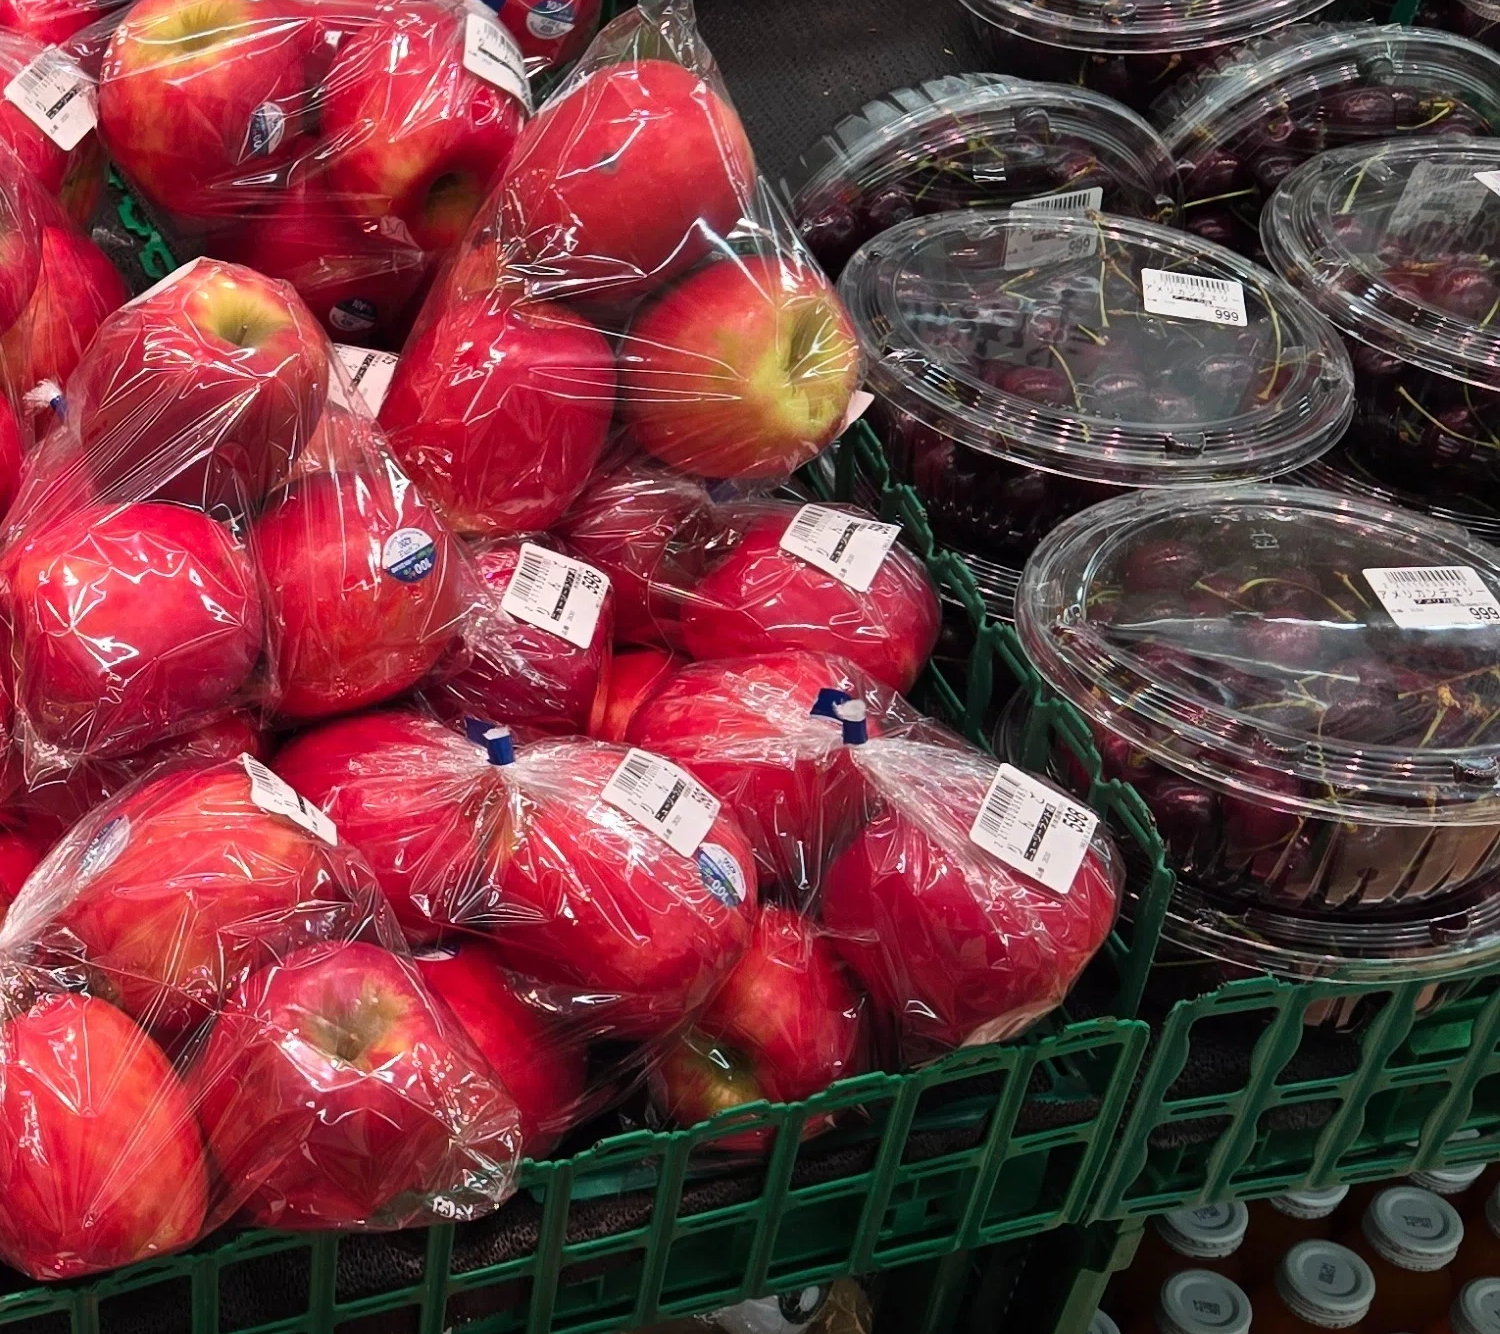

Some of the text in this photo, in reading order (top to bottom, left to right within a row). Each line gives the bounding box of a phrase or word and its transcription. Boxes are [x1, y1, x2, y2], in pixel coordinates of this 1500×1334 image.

[1214, 309, 1240, 323] 999
[582, 569, 603, 596] 598
[1378, 587, 1486, 601] アメリカンチェリー
[1468, 606, 1500, 621] 999
[1062, 804, 1090, 834] 598
